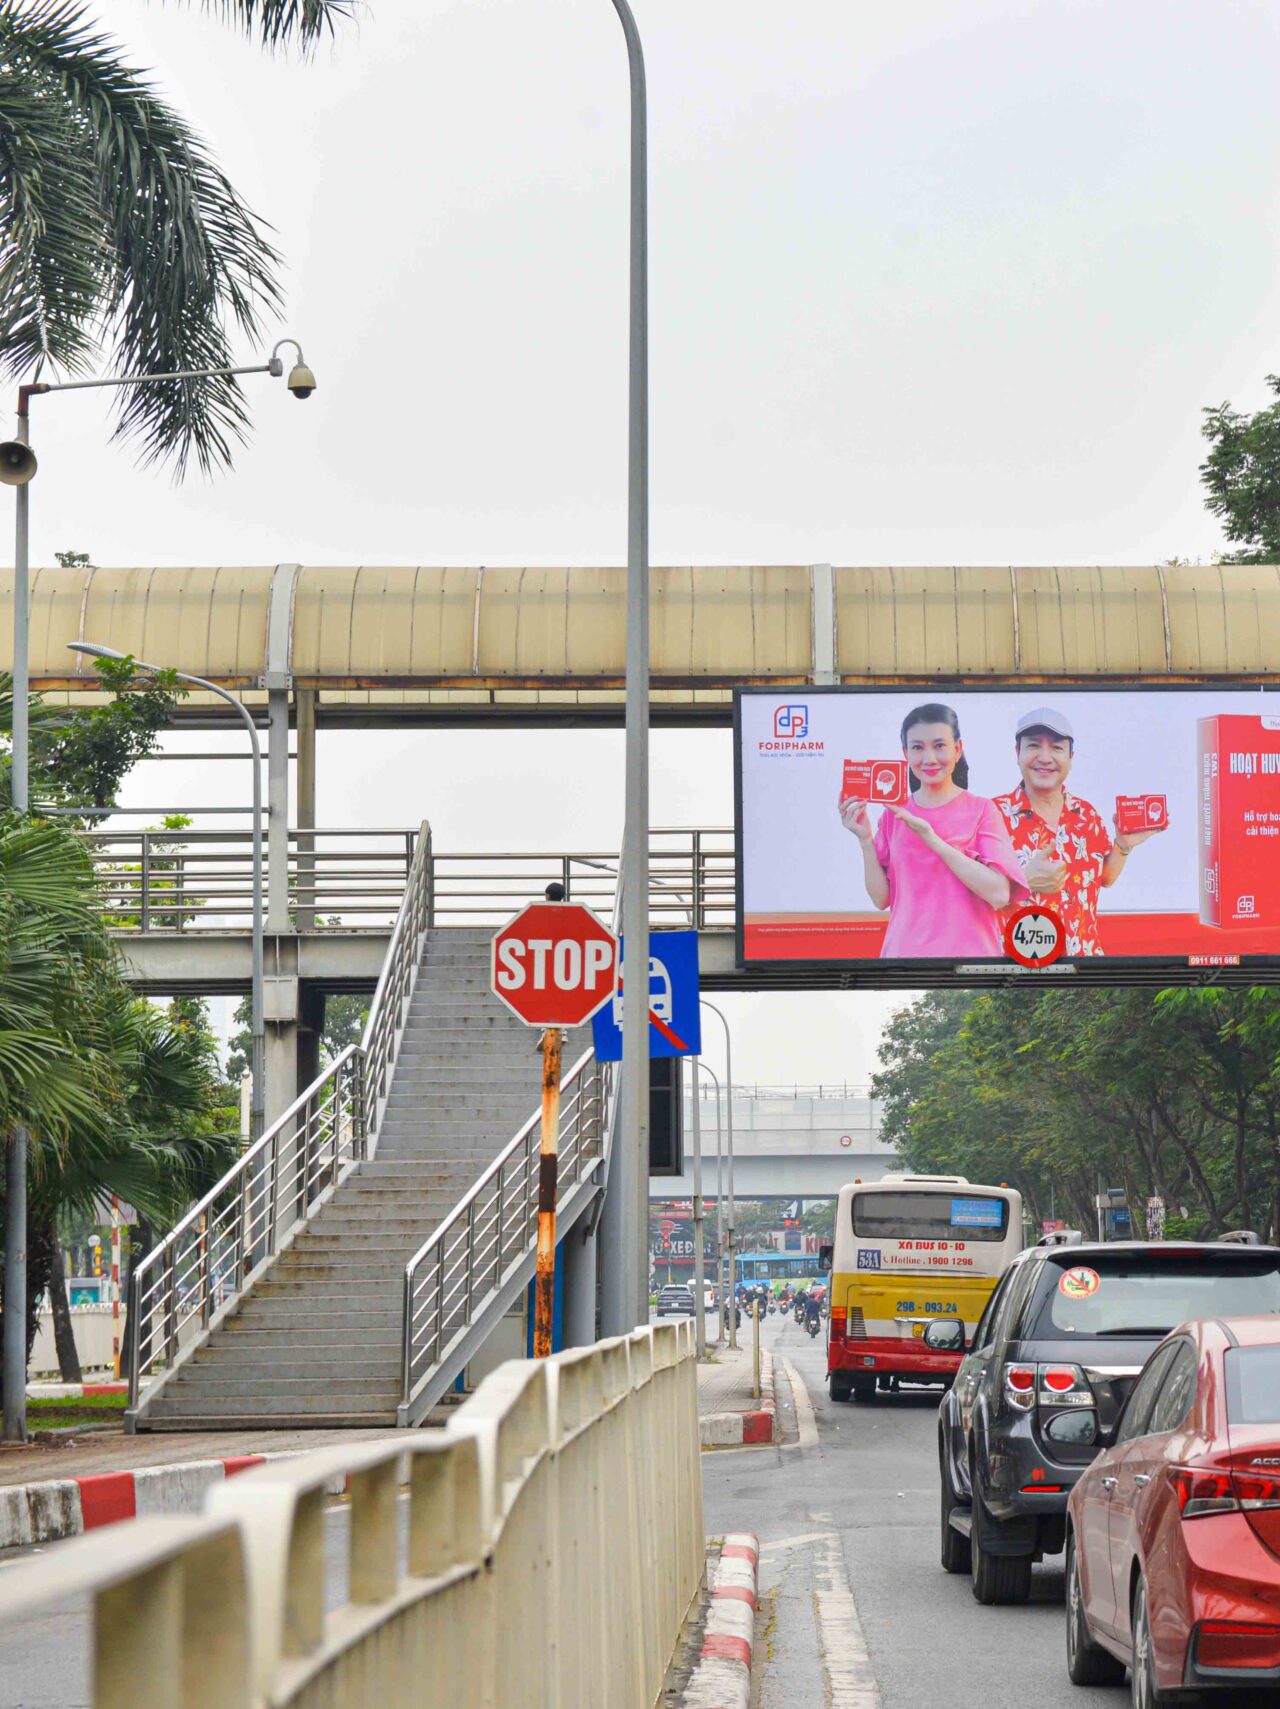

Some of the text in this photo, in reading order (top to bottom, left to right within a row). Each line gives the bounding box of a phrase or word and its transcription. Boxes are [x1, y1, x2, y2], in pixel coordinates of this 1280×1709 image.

[759, 742, 824, 750] FORIPHARM
[1230, 753, 1258, 779] HOẠT
[1014, 922, 1055, 945] 4,75m
[497, 938, 612, 990] STOP
[916, 1241, 934, 1250] BUS
[858, 1250, 880, 1268] 53A
[928, 1257, 948, 1265] 1900
